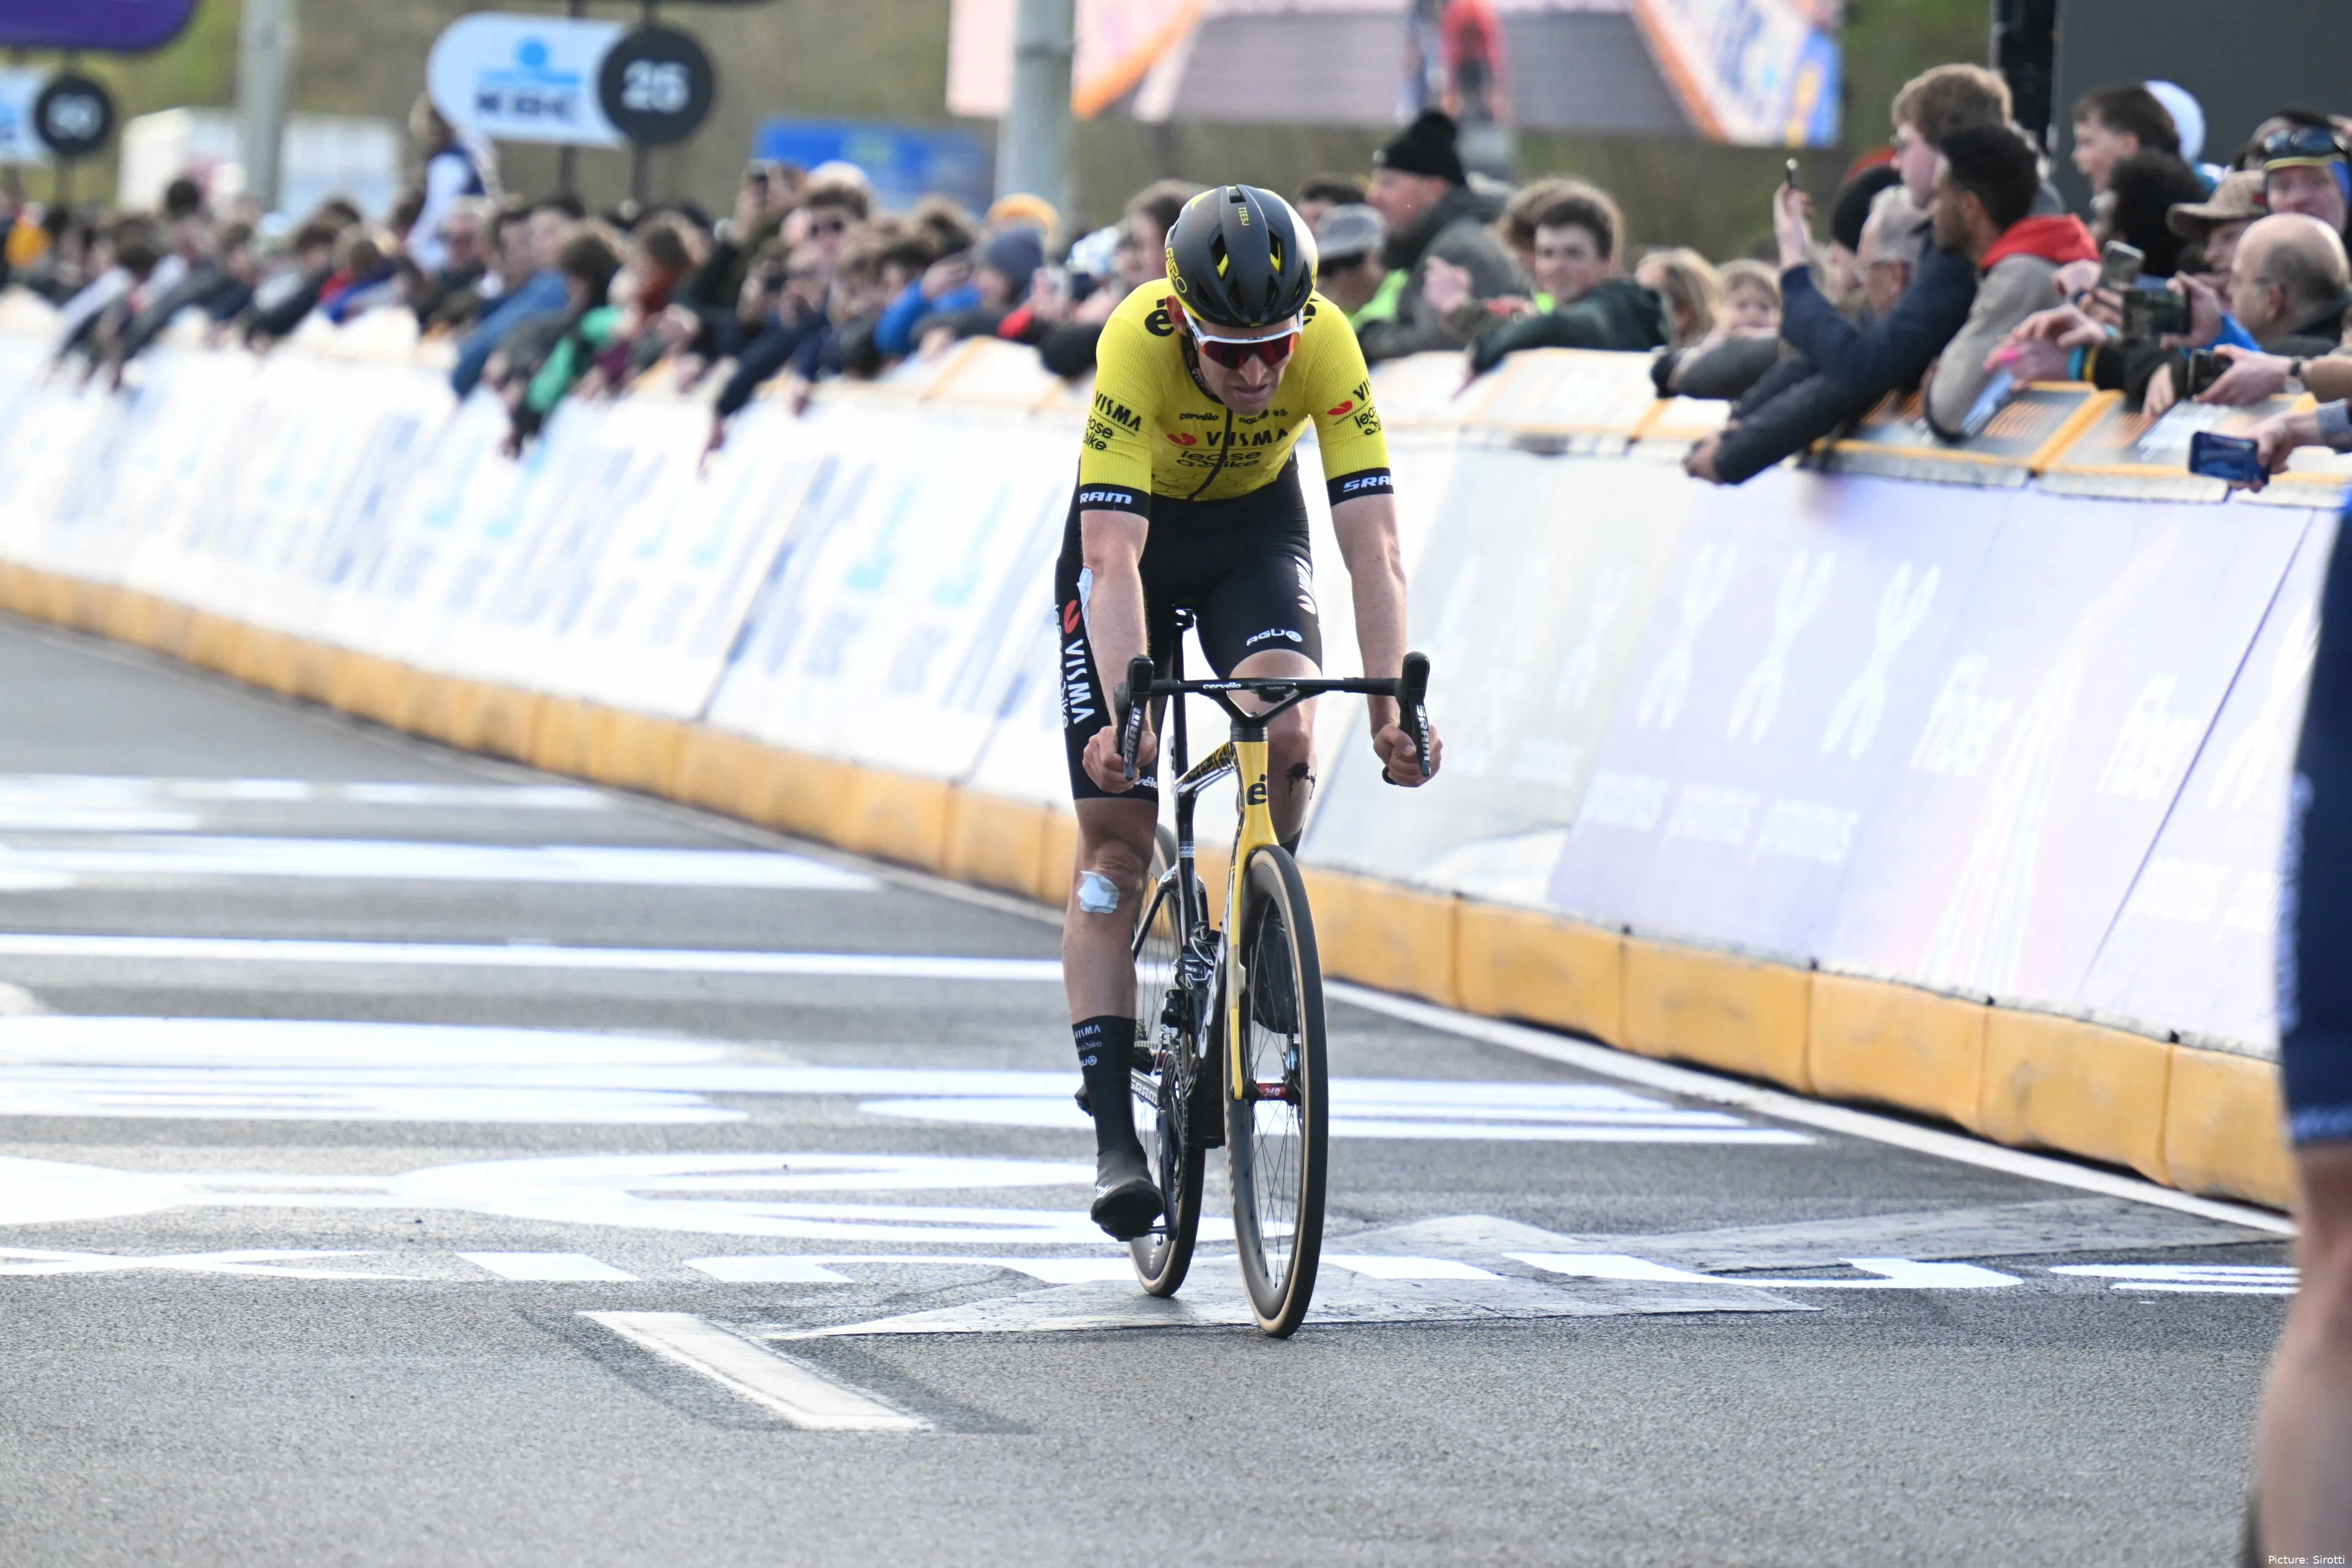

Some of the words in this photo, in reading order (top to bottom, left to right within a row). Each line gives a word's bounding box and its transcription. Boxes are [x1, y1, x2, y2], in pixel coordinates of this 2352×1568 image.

[622, 59, 690, 113] 25
[1237, 206, 1250, 227] TIESJ
[1166, 247, 1187, 293] GIRO
[1095, 390, 1142, 432] VISMA
[1180, 450, 1262, 461] lease
[1206, 428, 1289, 447] VISMA
[1343, 475, 1392, 492] SRA
[1065, 639, 1095, 725] VISMA
[1125, 707, 1142, 764] SRAM
[1416, 704, 1430, 761] SRAM
[1074, 1024, 1101, 1039] VISMA
